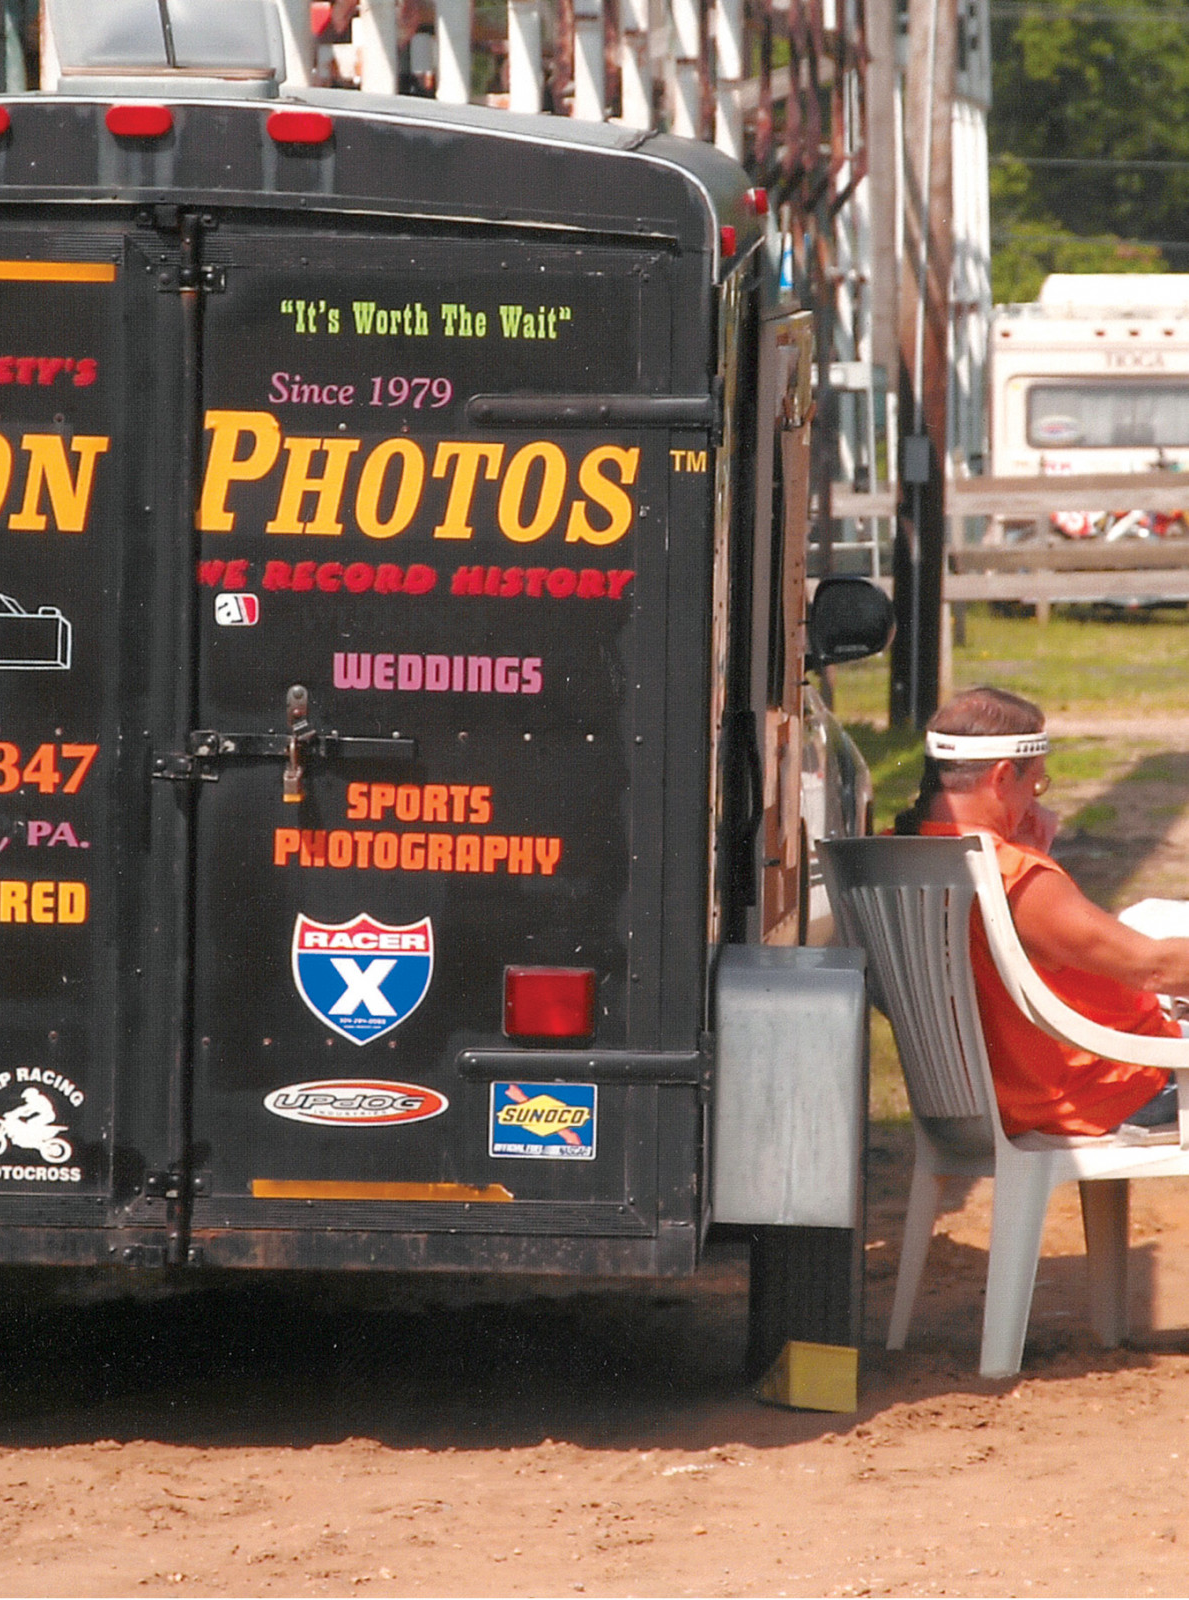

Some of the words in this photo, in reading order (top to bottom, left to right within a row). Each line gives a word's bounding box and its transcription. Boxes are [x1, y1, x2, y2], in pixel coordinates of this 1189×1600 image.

[353, 302, 429, 335] Worth
[442, 304, 487, 337] The
[268, 372, 354, 406] Since
[369, 376, 454, 409] 1979
[195, 410, 640, 545] PHOTOS
[262, 561, 437, 595] RECORD
[451, 566, 635, 600] HISTORY
[333, 652, 544, 694] WEDDINGS
[347, 782, 493, 824] SPORTS
[27, 819, 91, 848] PA.
[274, 828, 562, 876] PHOTOGRAPHY
[304, 931, 427, 951] RACER
[328, 958, 398, 1016] X
[16, 1067, 85, 1108] RACING
[502, 1108, 586, 1123] SUNOCO
